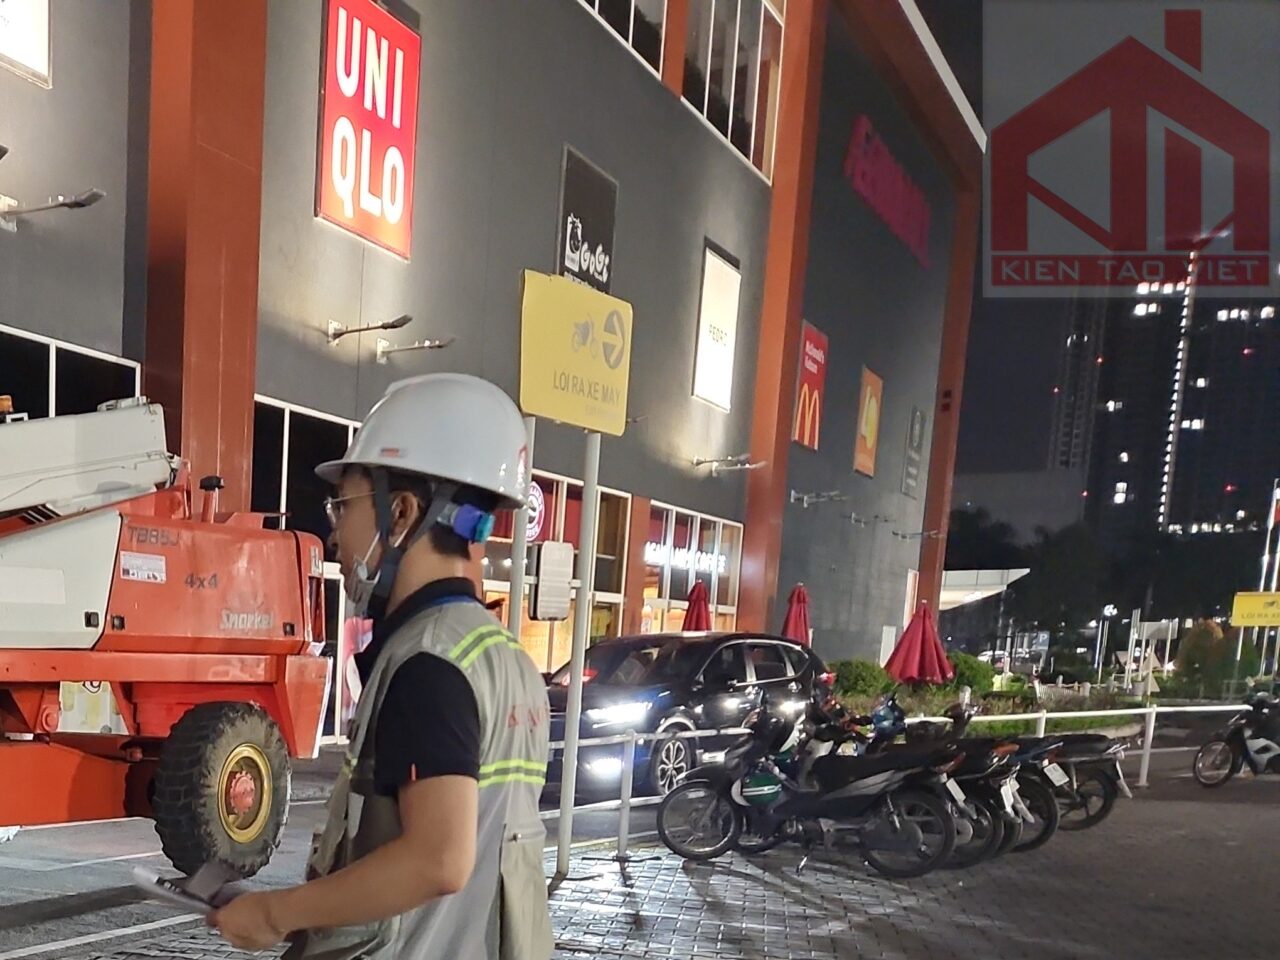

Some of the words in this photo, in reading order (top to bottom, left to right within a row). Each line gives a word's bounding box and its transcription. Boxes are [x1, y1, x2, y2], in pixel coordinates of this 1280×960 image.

[335, 6, 404, 129] UNI
[331, 116, 405, 225] QLO
[184, 573, 219, 590] 4x4
